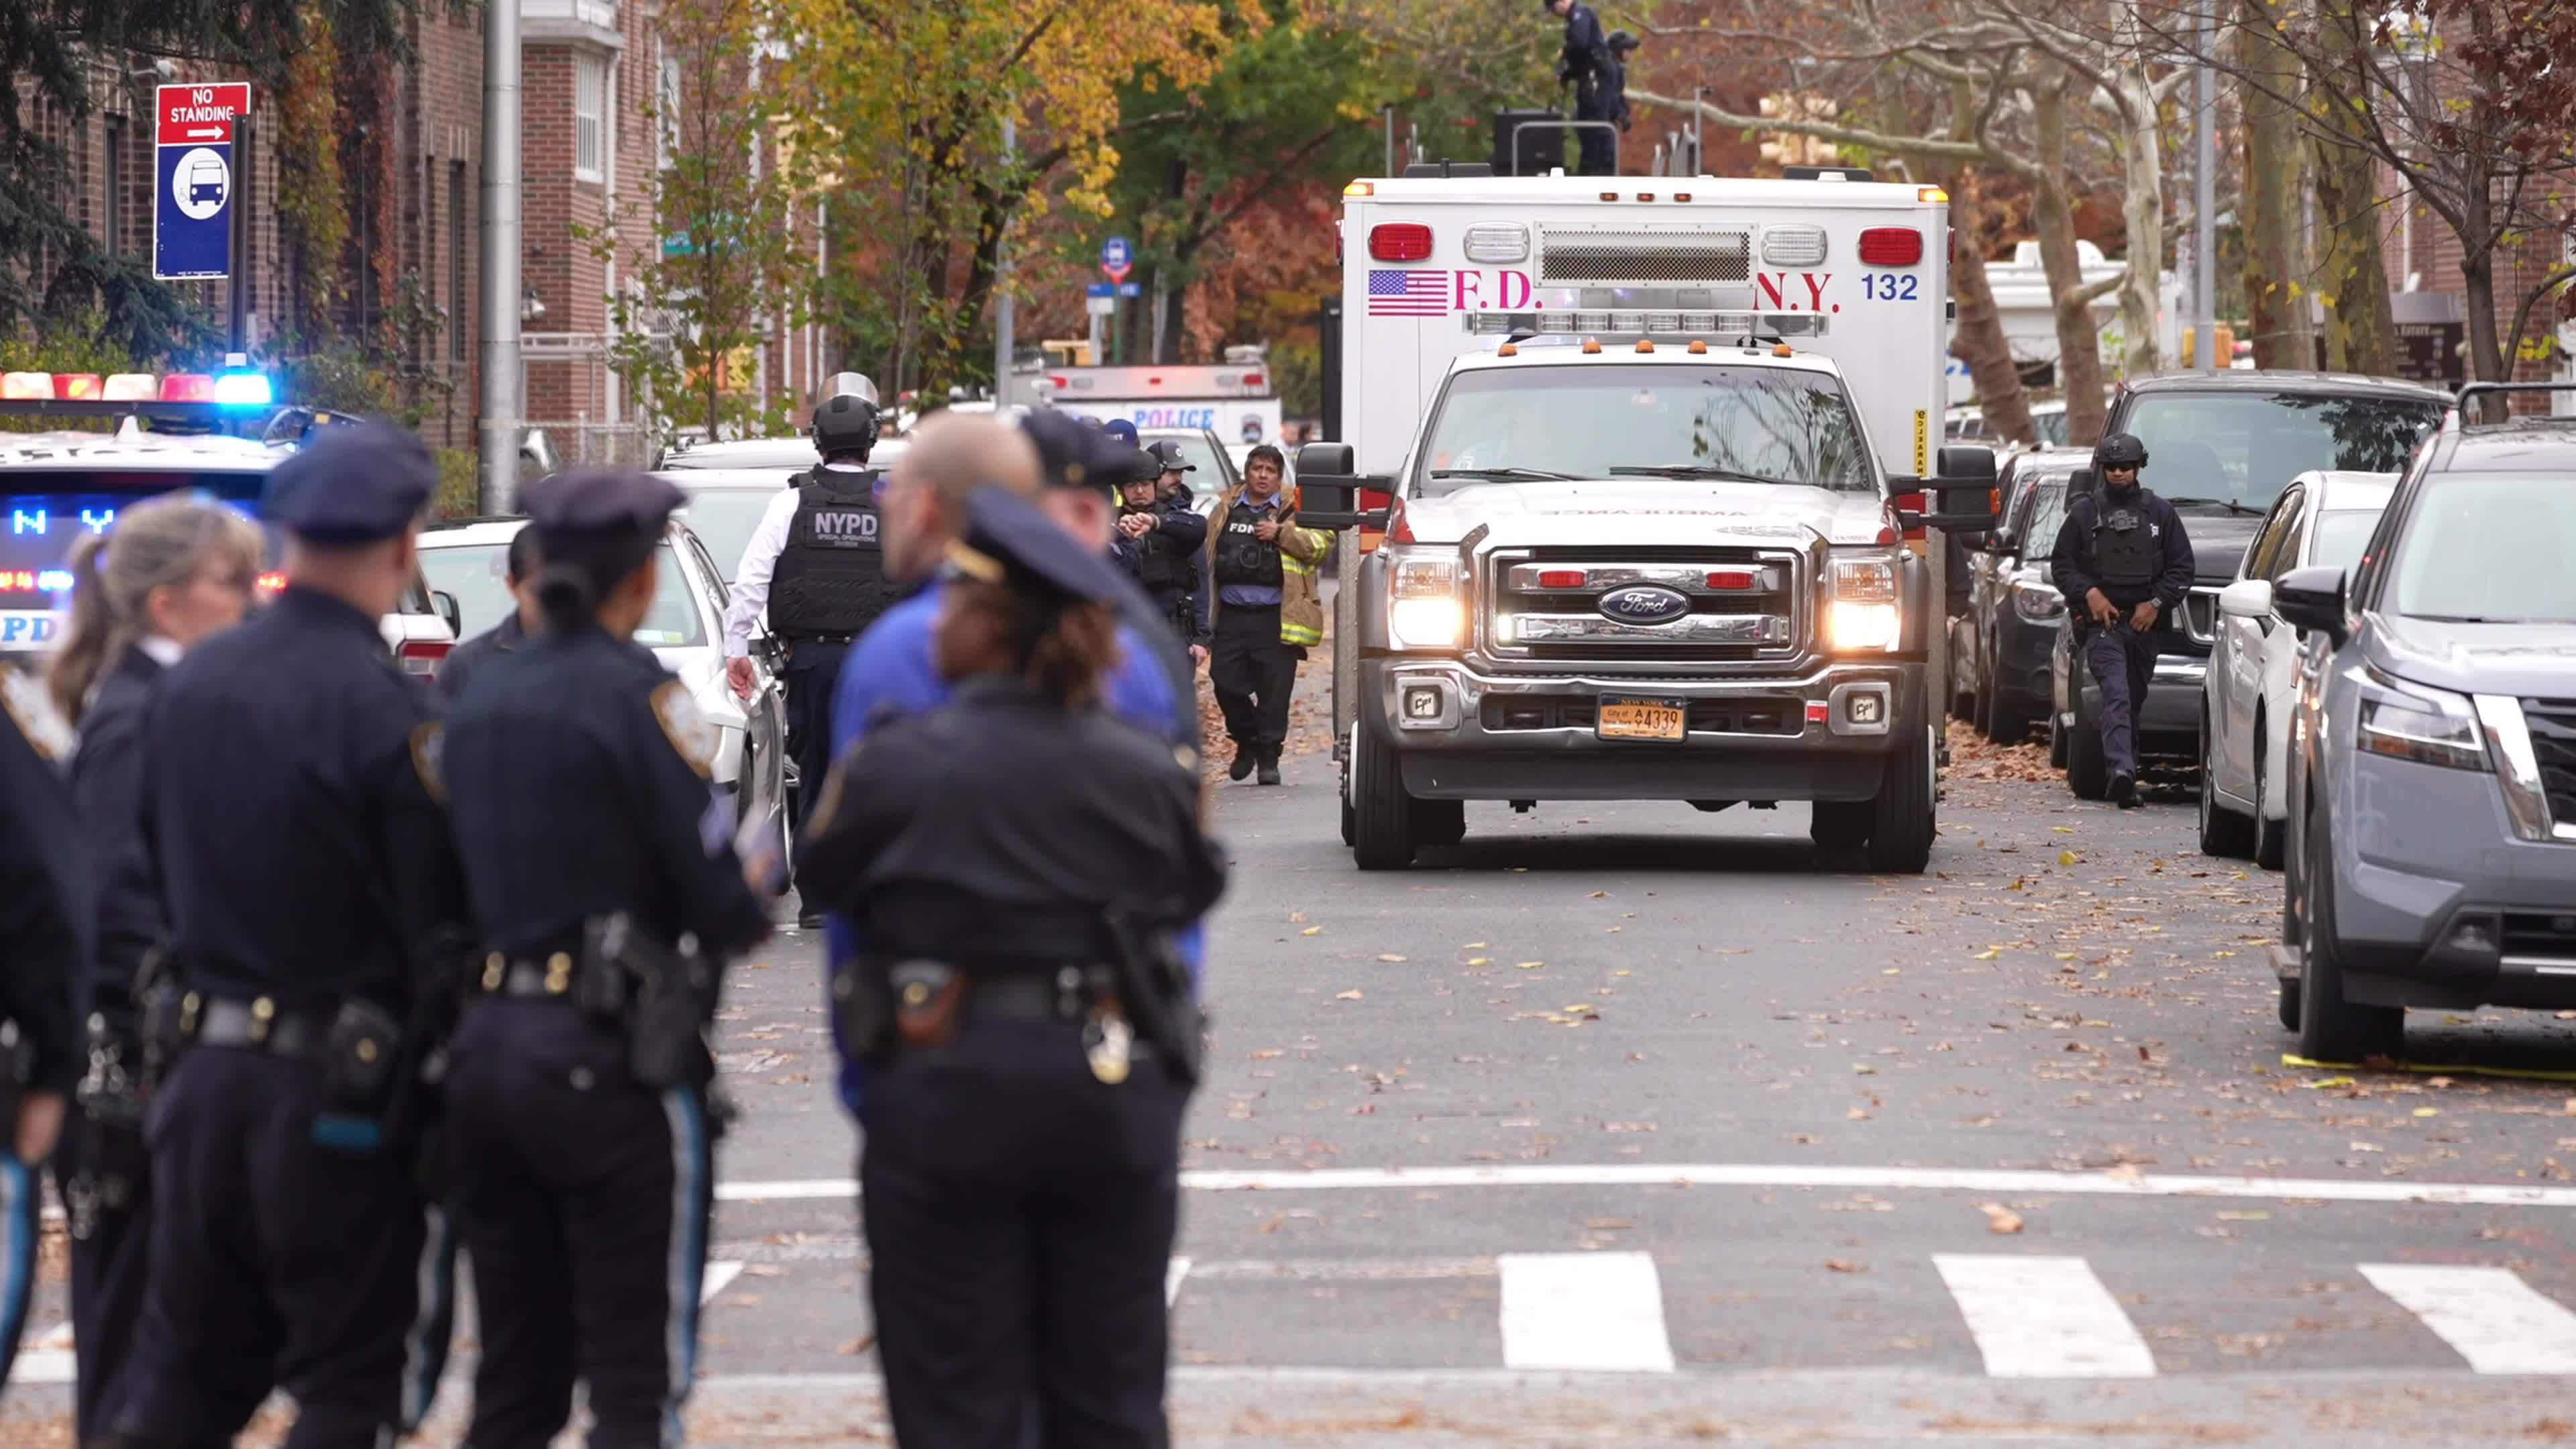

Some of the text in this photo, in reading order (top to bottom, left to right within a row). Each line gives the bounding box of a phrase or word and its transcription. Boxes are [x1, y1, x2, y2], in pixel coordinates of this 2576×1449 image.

[193, 89, 213, 105] NO
[170, 106, 234, 123] STANDING
[1454, 270, 1839, 313] F.D. N.Y.
[1862, 274, 1917, 300] 132
[1134, 408, 1214, 430] POLICE
[815, 513, 877, 535] NYPD
[1229, 523, 1256, 534] FDN
[1620, 592, 1668, 612] Ford
[1644, 710, 1678, 731] 4339
